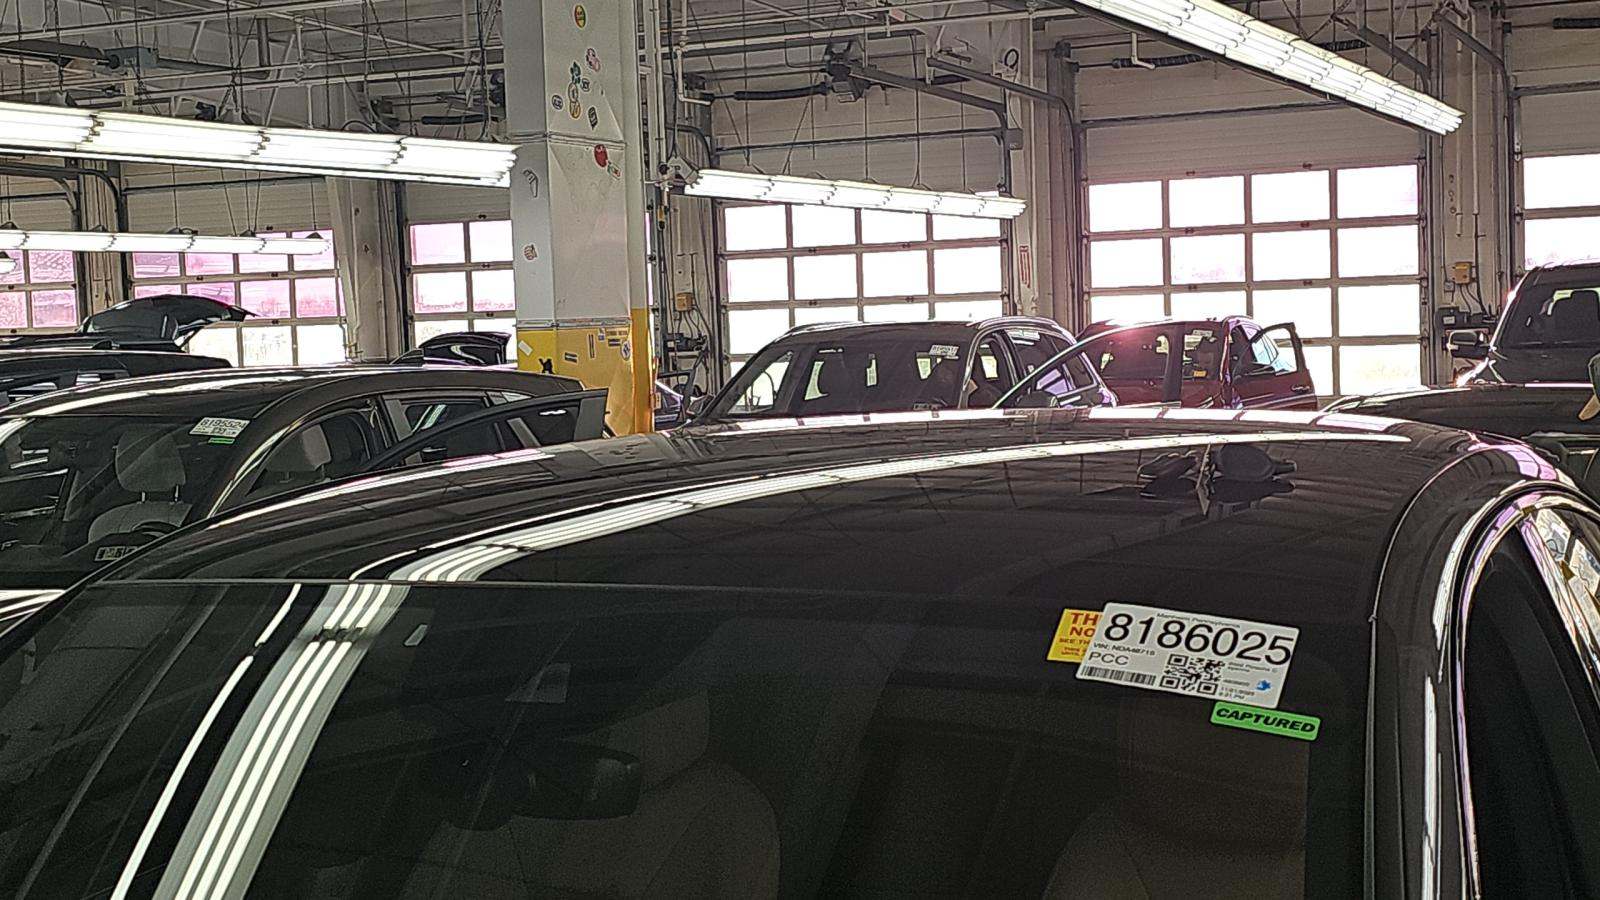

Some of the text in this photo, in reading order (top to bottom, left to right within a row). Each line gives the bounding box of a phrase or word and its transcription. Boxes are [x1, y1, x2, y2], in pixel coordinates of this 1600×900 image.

[1070, 612, 1102, 626] TH
[1104, 613, 1294, 666] 8186025
[1088, 651, 1129, 666] PCC
[1216, 707, 1316, 733] CAPTURED
